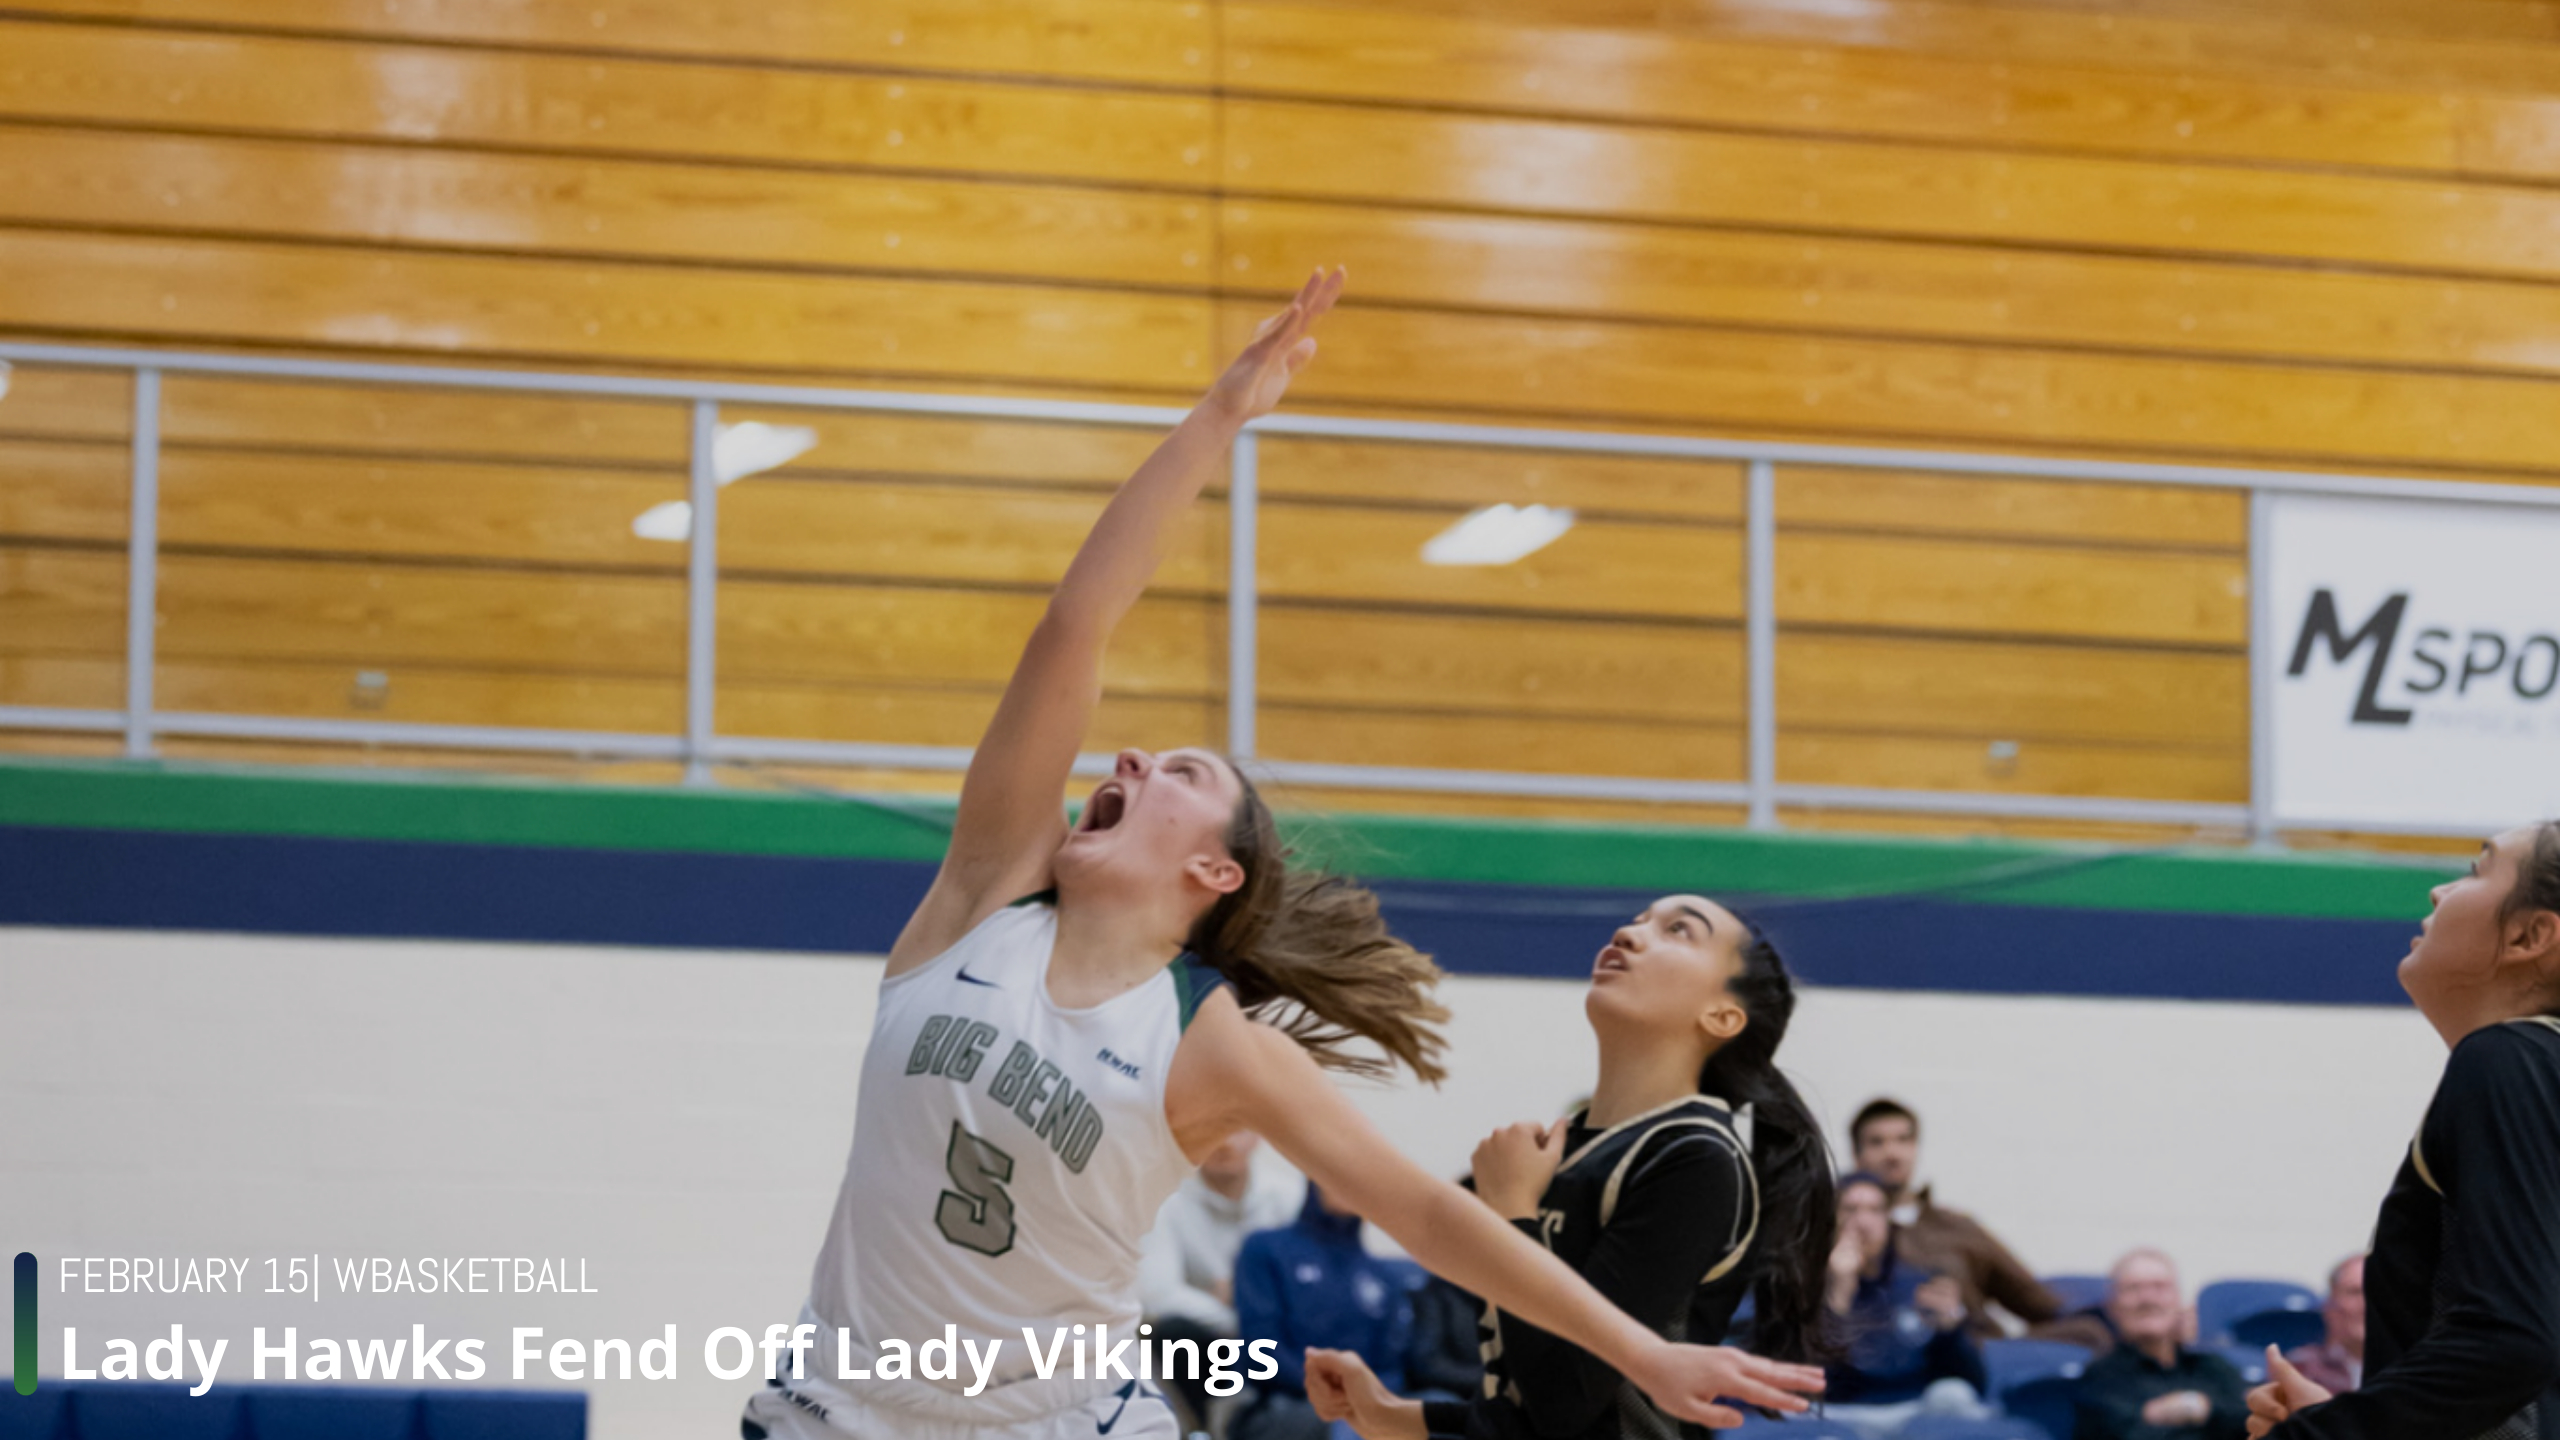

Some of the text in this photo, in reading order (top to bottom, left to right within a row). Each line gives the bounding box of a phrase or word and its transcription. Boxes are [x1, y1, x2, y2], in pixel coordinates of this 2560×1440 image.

[905, 1014, 1104, 1175] BIG BEND
[934, 1118, 1016, 1258] 5
